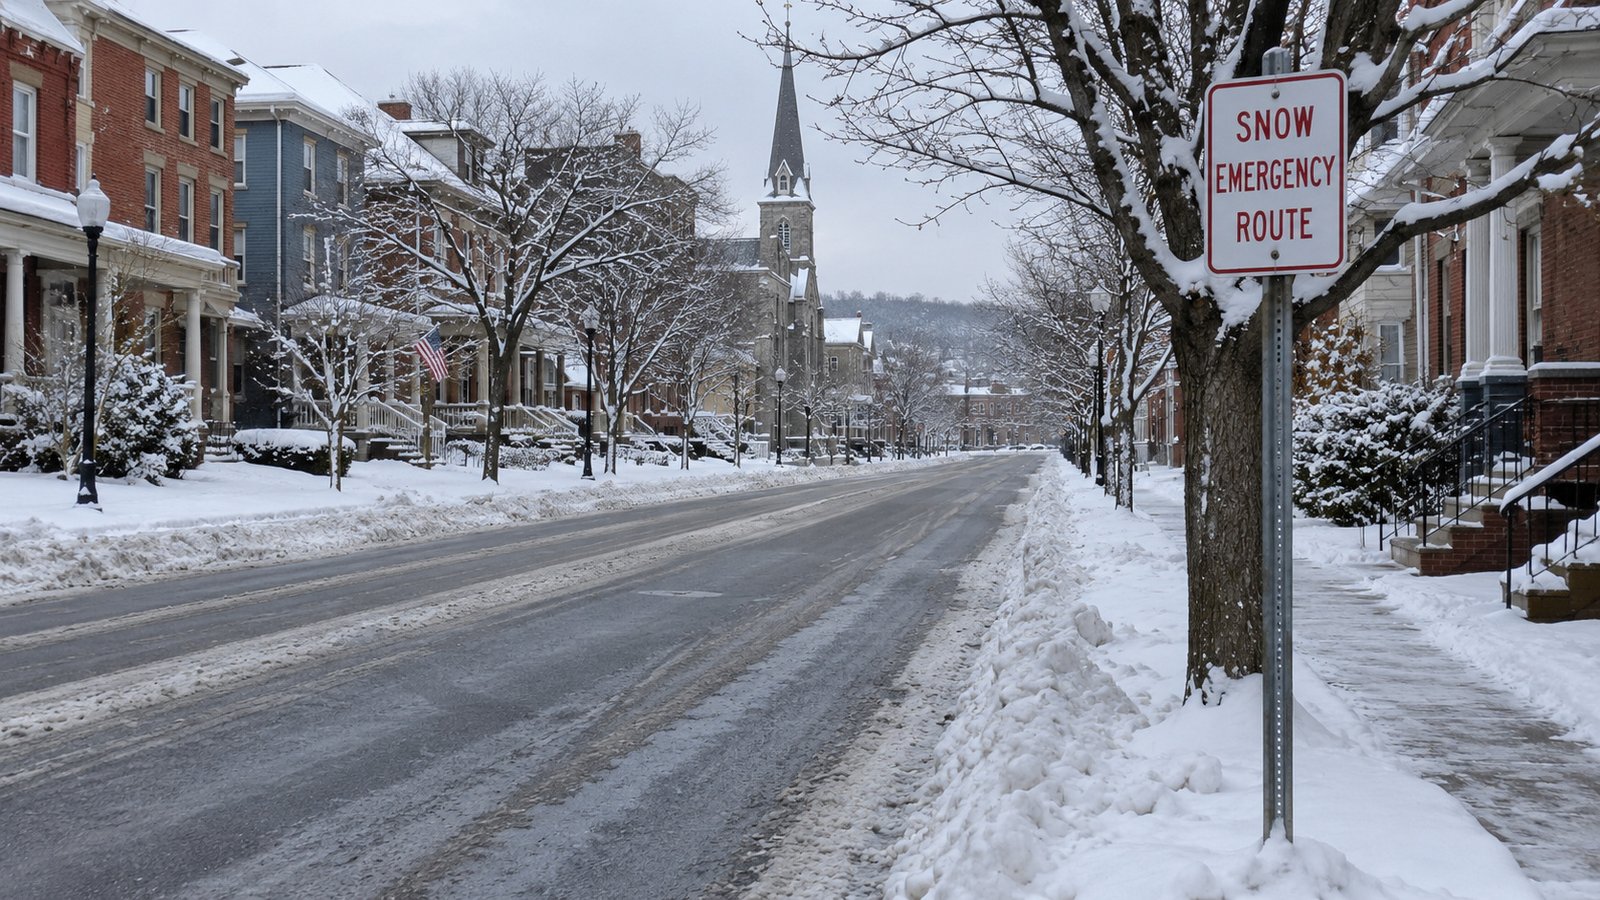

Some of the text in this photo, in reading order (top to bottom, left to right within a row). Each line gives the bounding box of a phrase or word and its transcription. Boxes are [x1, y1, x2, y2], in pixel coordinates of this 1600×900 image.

[1236, 105, 1314, 142] SNOW
[1216, 155, 1335, 193] EMERGENCY
[1236, 207, 1313, 243] ROUTE
